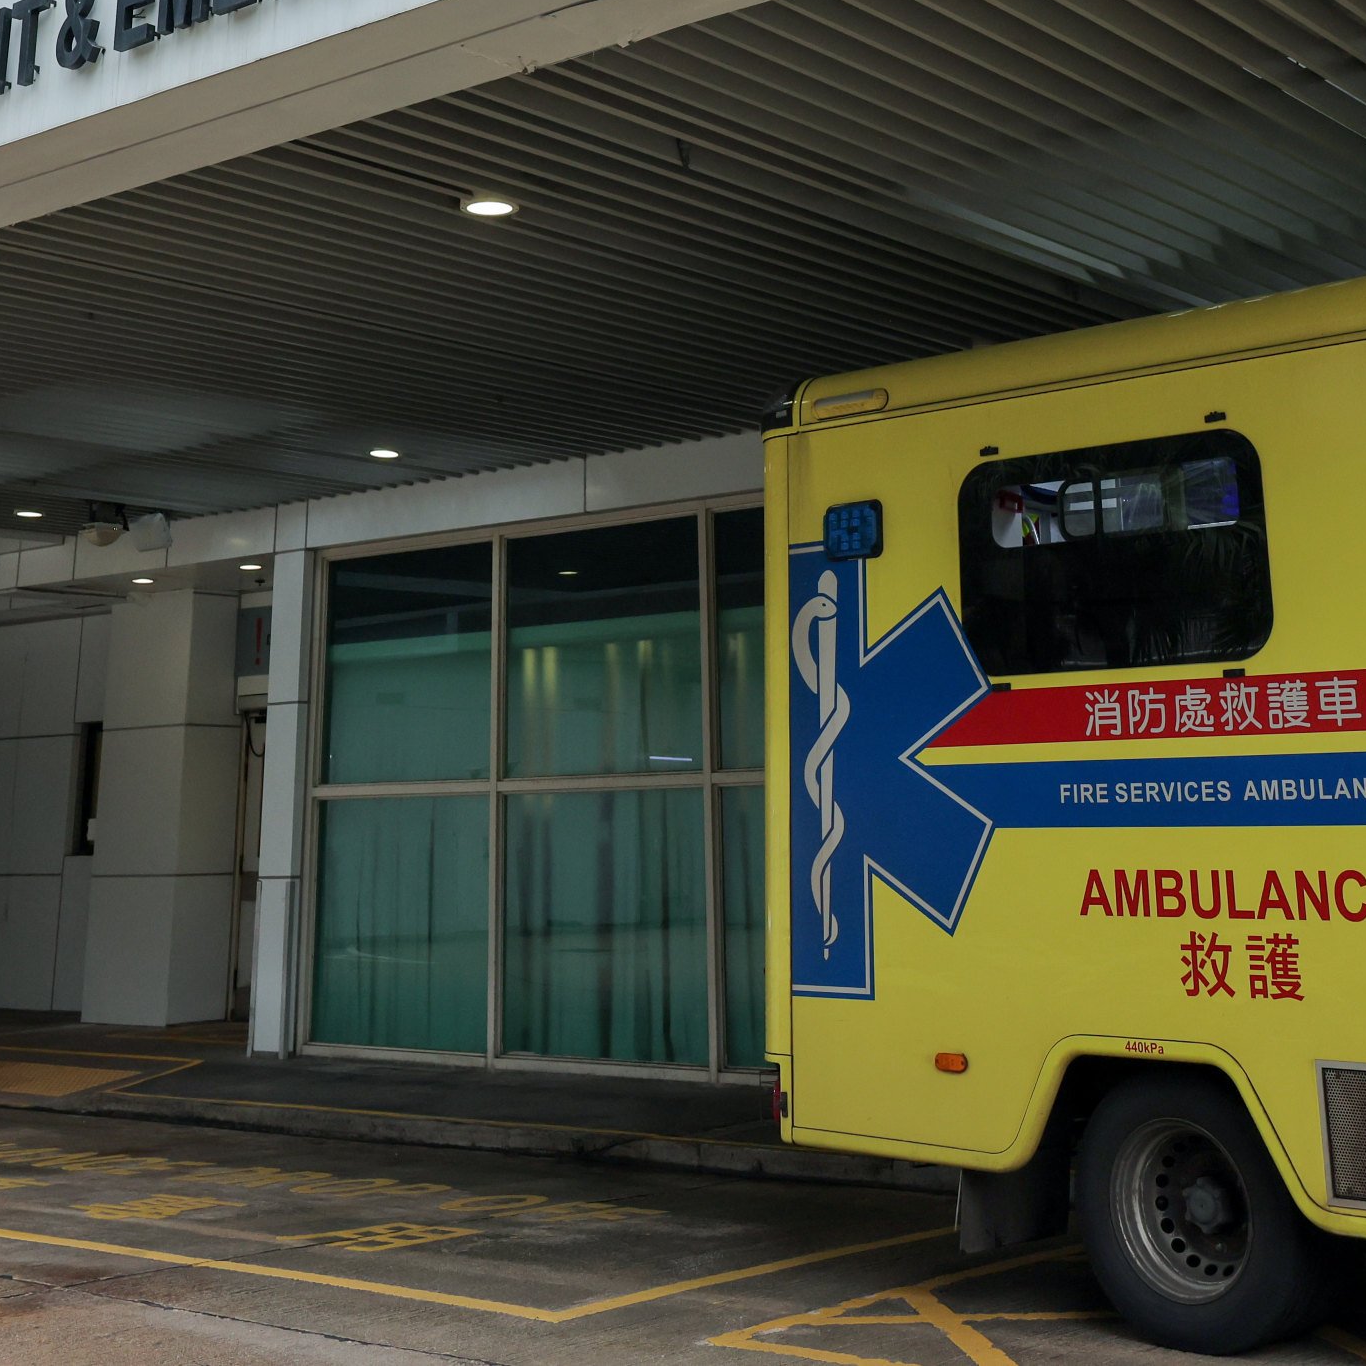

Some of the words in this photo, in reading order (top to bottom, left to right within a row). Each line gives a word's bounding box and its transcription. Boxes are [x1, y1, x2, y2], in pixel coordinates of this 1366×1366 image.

[1084, 676, 1363, 737] 消防處救護車
[1059, 783, 1109, 804] FIRE
[1114, 781, 1232, 803] SERVICES
[1179, 930, 1306, 1002] 救護
[1124, 1040, 1164, 1055] 440kPa
